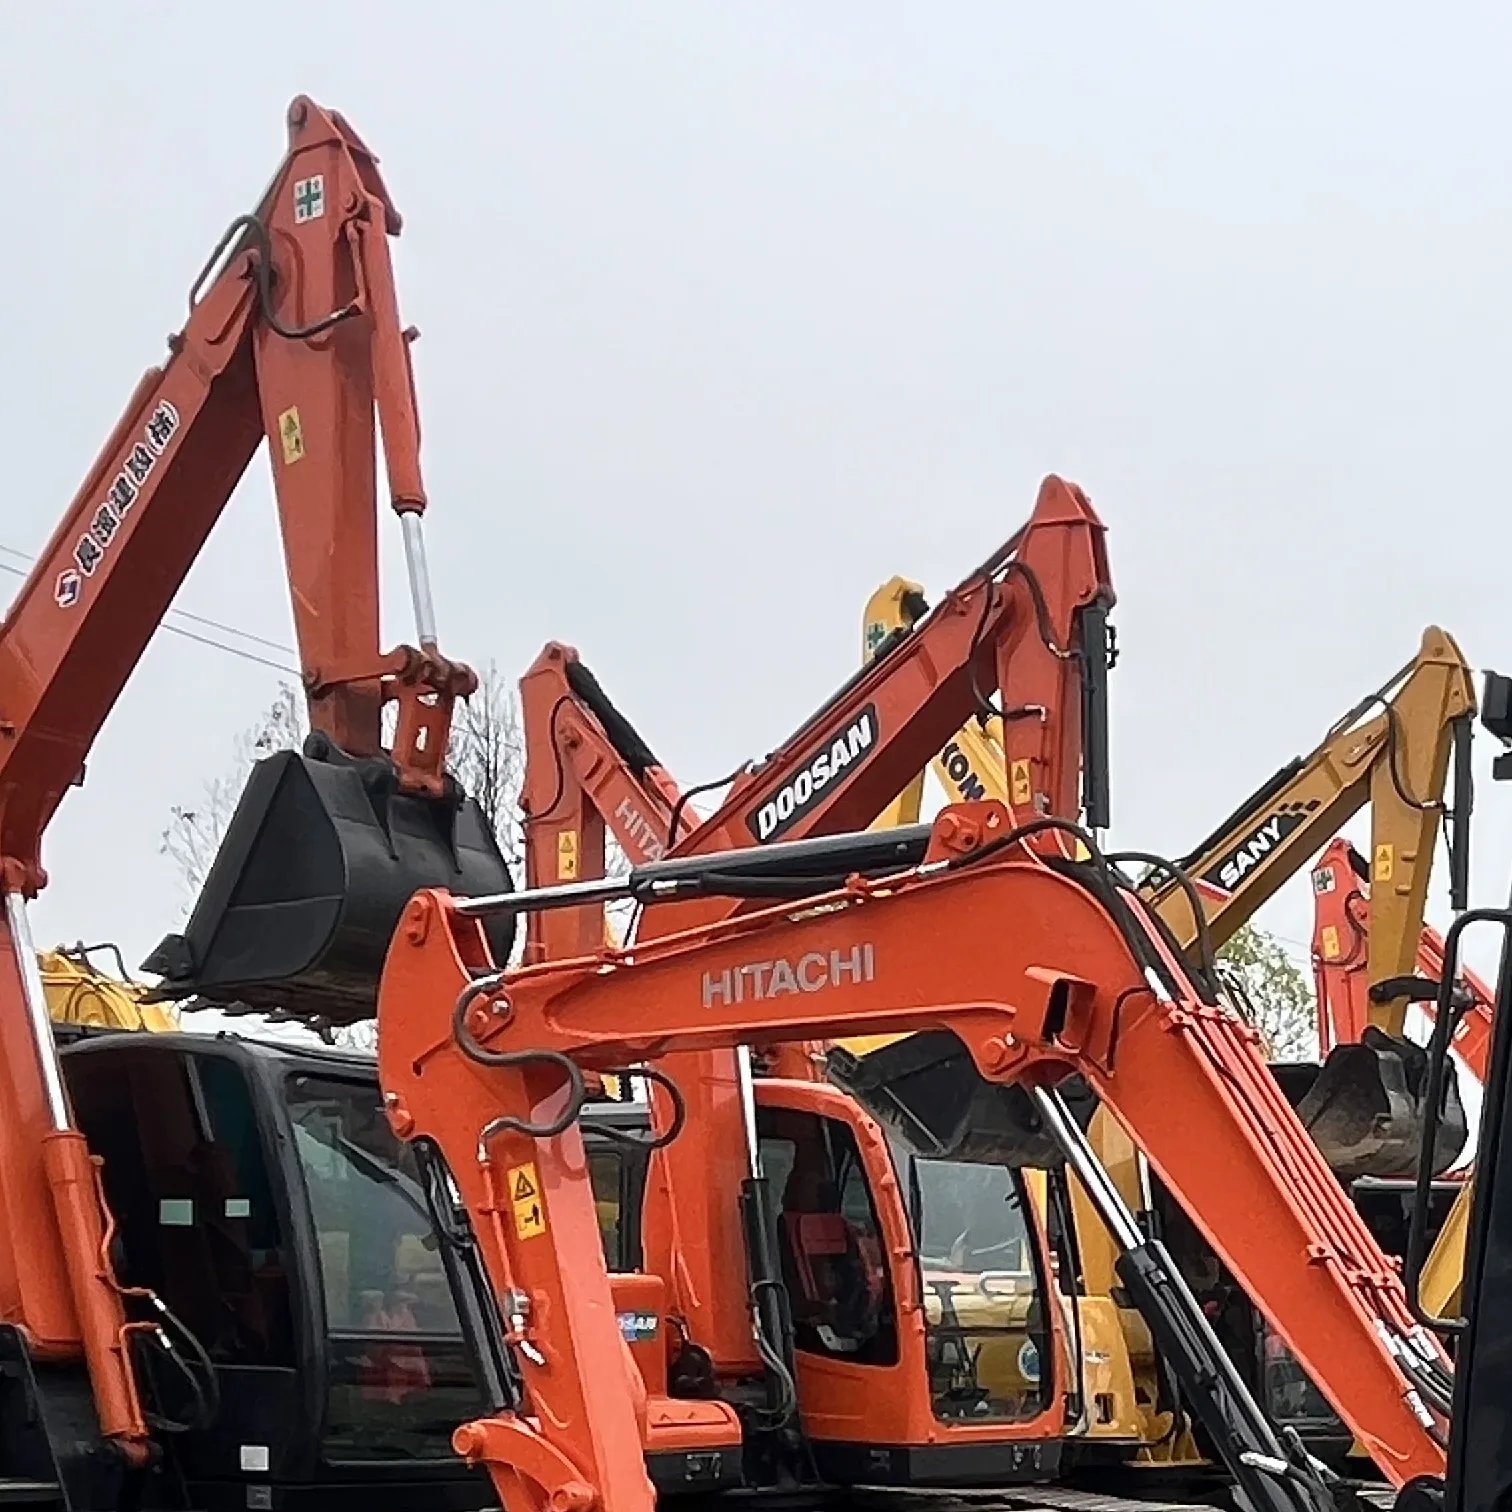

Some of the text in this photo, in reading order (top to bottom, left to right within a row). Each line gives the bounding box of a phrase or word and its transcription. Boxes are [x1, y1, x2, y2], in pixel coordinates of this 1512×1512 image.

[757, 714, 873, 840] DOOSAN
[1219, 816, 1282, 888] SANY
[702, 942, 874, 1008] HITACHI
